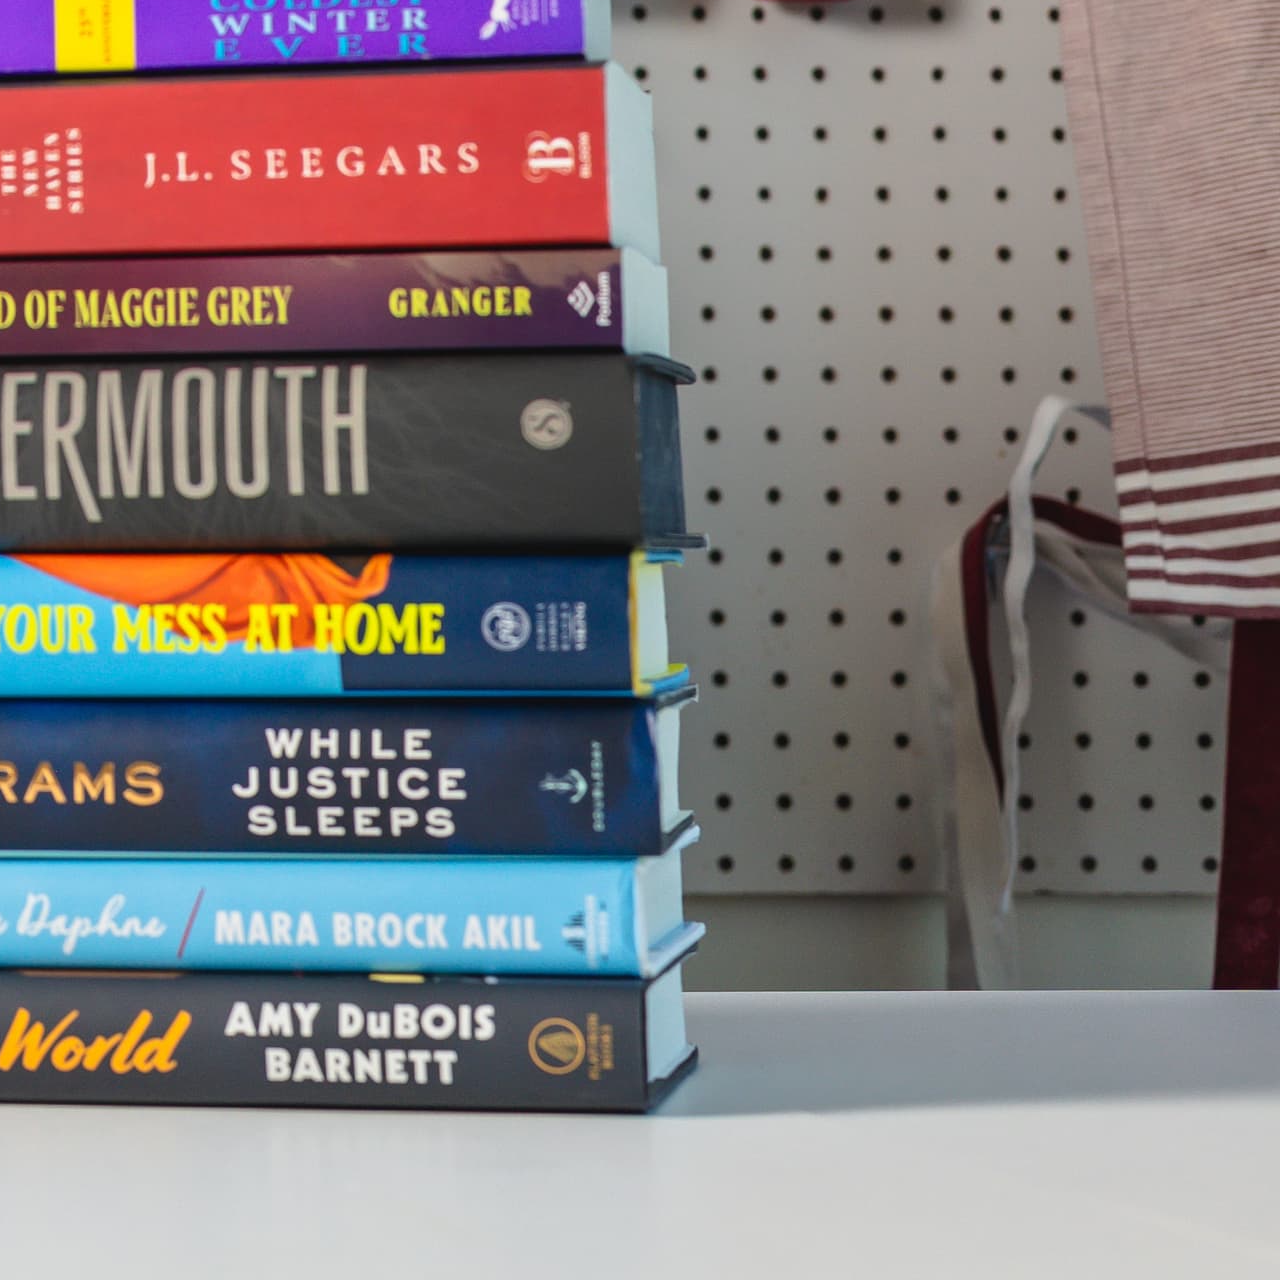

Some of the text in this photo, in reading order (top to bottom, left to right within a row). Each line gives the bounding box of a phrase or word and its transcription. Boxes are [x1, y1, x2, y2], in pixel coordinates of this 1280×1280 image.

[209, 8, 429, 35] WINTER
[214, 34, 429, 60] EVER
[0, 150, 17, 197] THE
[22, 148, 39, 197] NEW
[43, 132, 62, 210] HAVEN
[66, 127, 85, 214] SERIES
[145, 141, 481, 188] J.L. SEEGARS
[22, 291, 66, 329] OF
[74, 287, 201, 329] MAGGIE
[207, 284, 293, 327] GREY
[389, 284, 535, 321] GRANGER
[596, 272, 611, 327] Podium
[112, 602, 228, 655] MESS
[244, 602, 299, 654] AT
[313, 602, 446, 655] HOME
[265, 728, 433, 762] WHILE
[232, 766, 468, 802] JUSTICE
[248, 805, 456, 839] SLEEPS
[19, 894, 168, 956] Daphne
[214, 908, 321, 947] MARA
[329, 912, 449, 951] BROCK
[461, 913, 543, 953] AKIL
[3, 1009, 192, 1075] World
[224, 1001, 496, 1041] AMY DuBOIS
[264, 1047, 458, 1086] BARNETT
